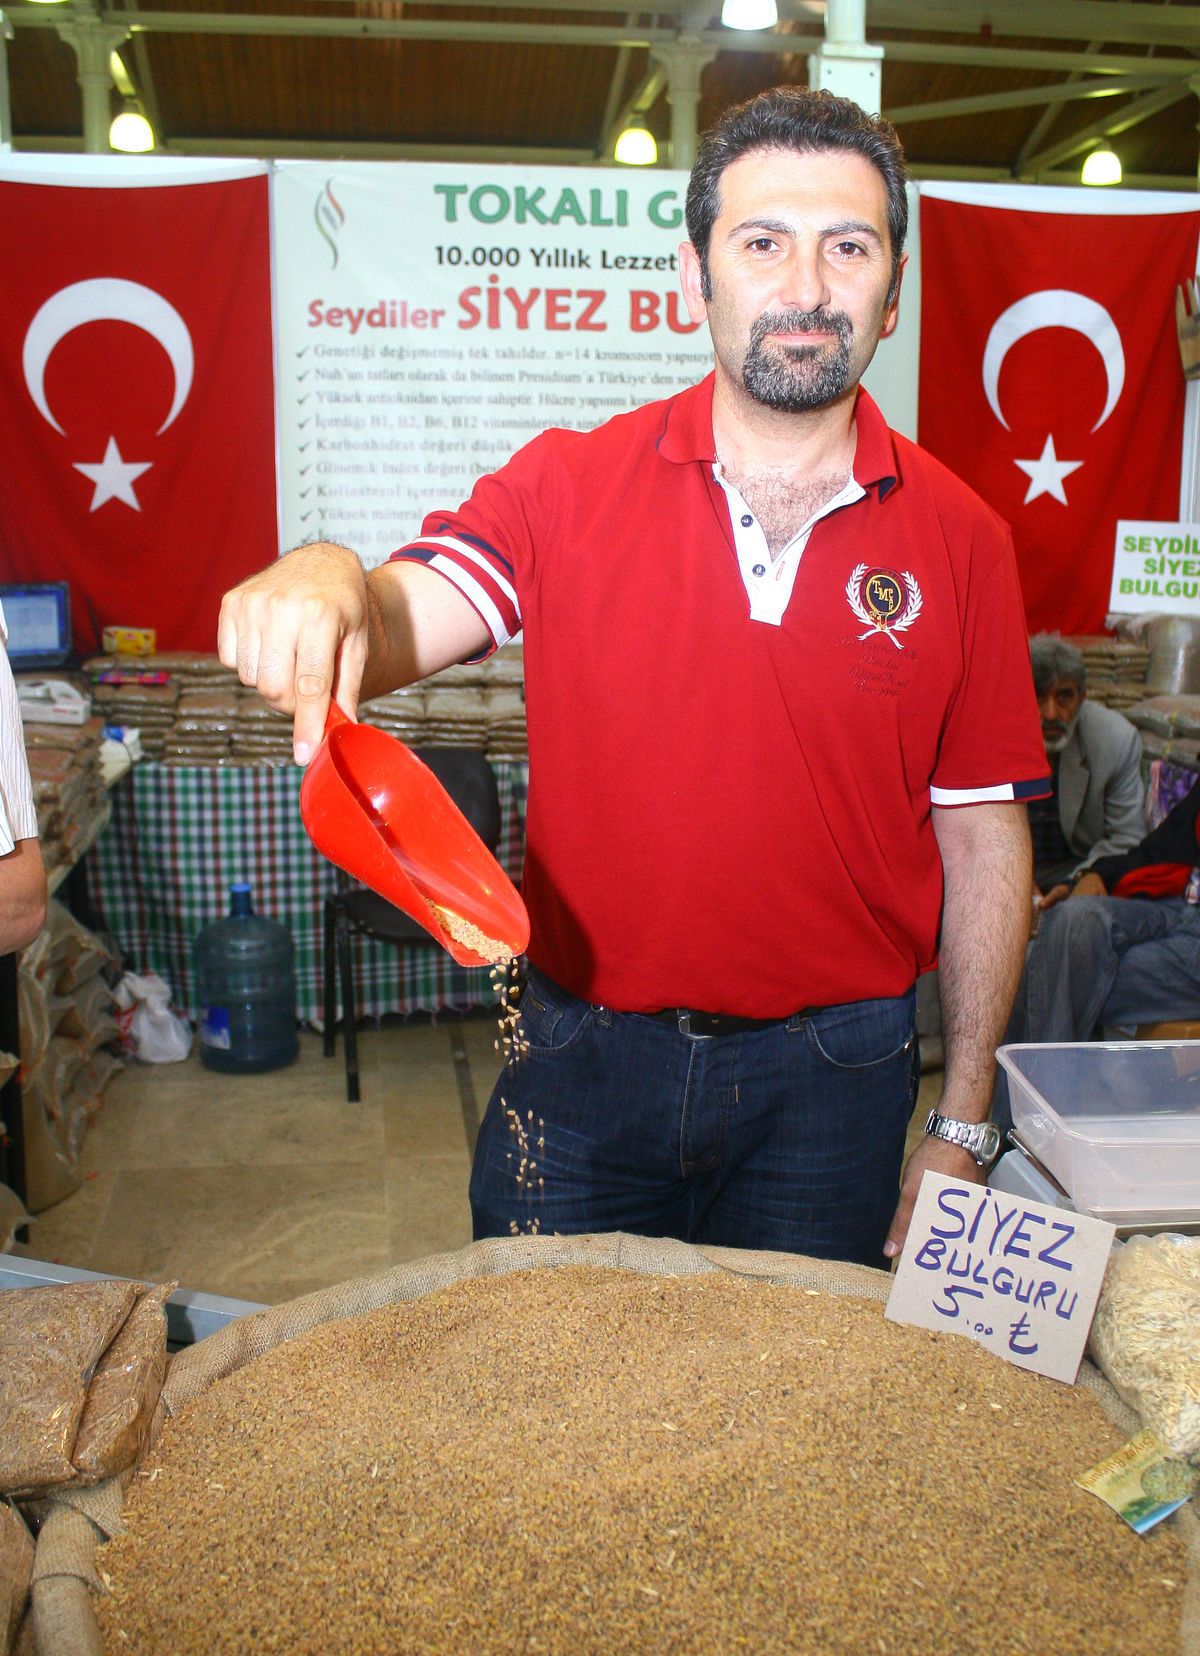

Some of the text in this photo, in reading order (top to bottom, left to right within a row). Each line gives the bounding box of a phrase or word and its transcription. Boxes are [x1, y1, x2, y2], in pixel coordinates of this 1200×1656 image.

[433, 184, 684, 229] TOKALI G
[435, 246, 677, 271] 10.000 Yıllık Lezzet
[307, 298, 446, 335] Seydiler
[457, 273, 608, 331] SİYEZ
[468, 346, 489, 359] tek
[594, 347, 662, 362] kromozom
[408, 368, 448, 381] olarak
[451, 369, 467, 382] da
[470, 369, 515, 382] bilinen
[314, 389, 362, 403] Yüksek
[538, 392, 576, 406] Hücre
[420, 438, 466, 454] değeri
[1143, 555, 1200, 577] SİYE
[930, 1187, 1076, 1272] SİYEZ
[914, 1238, 1079, 1321] BULGURU
